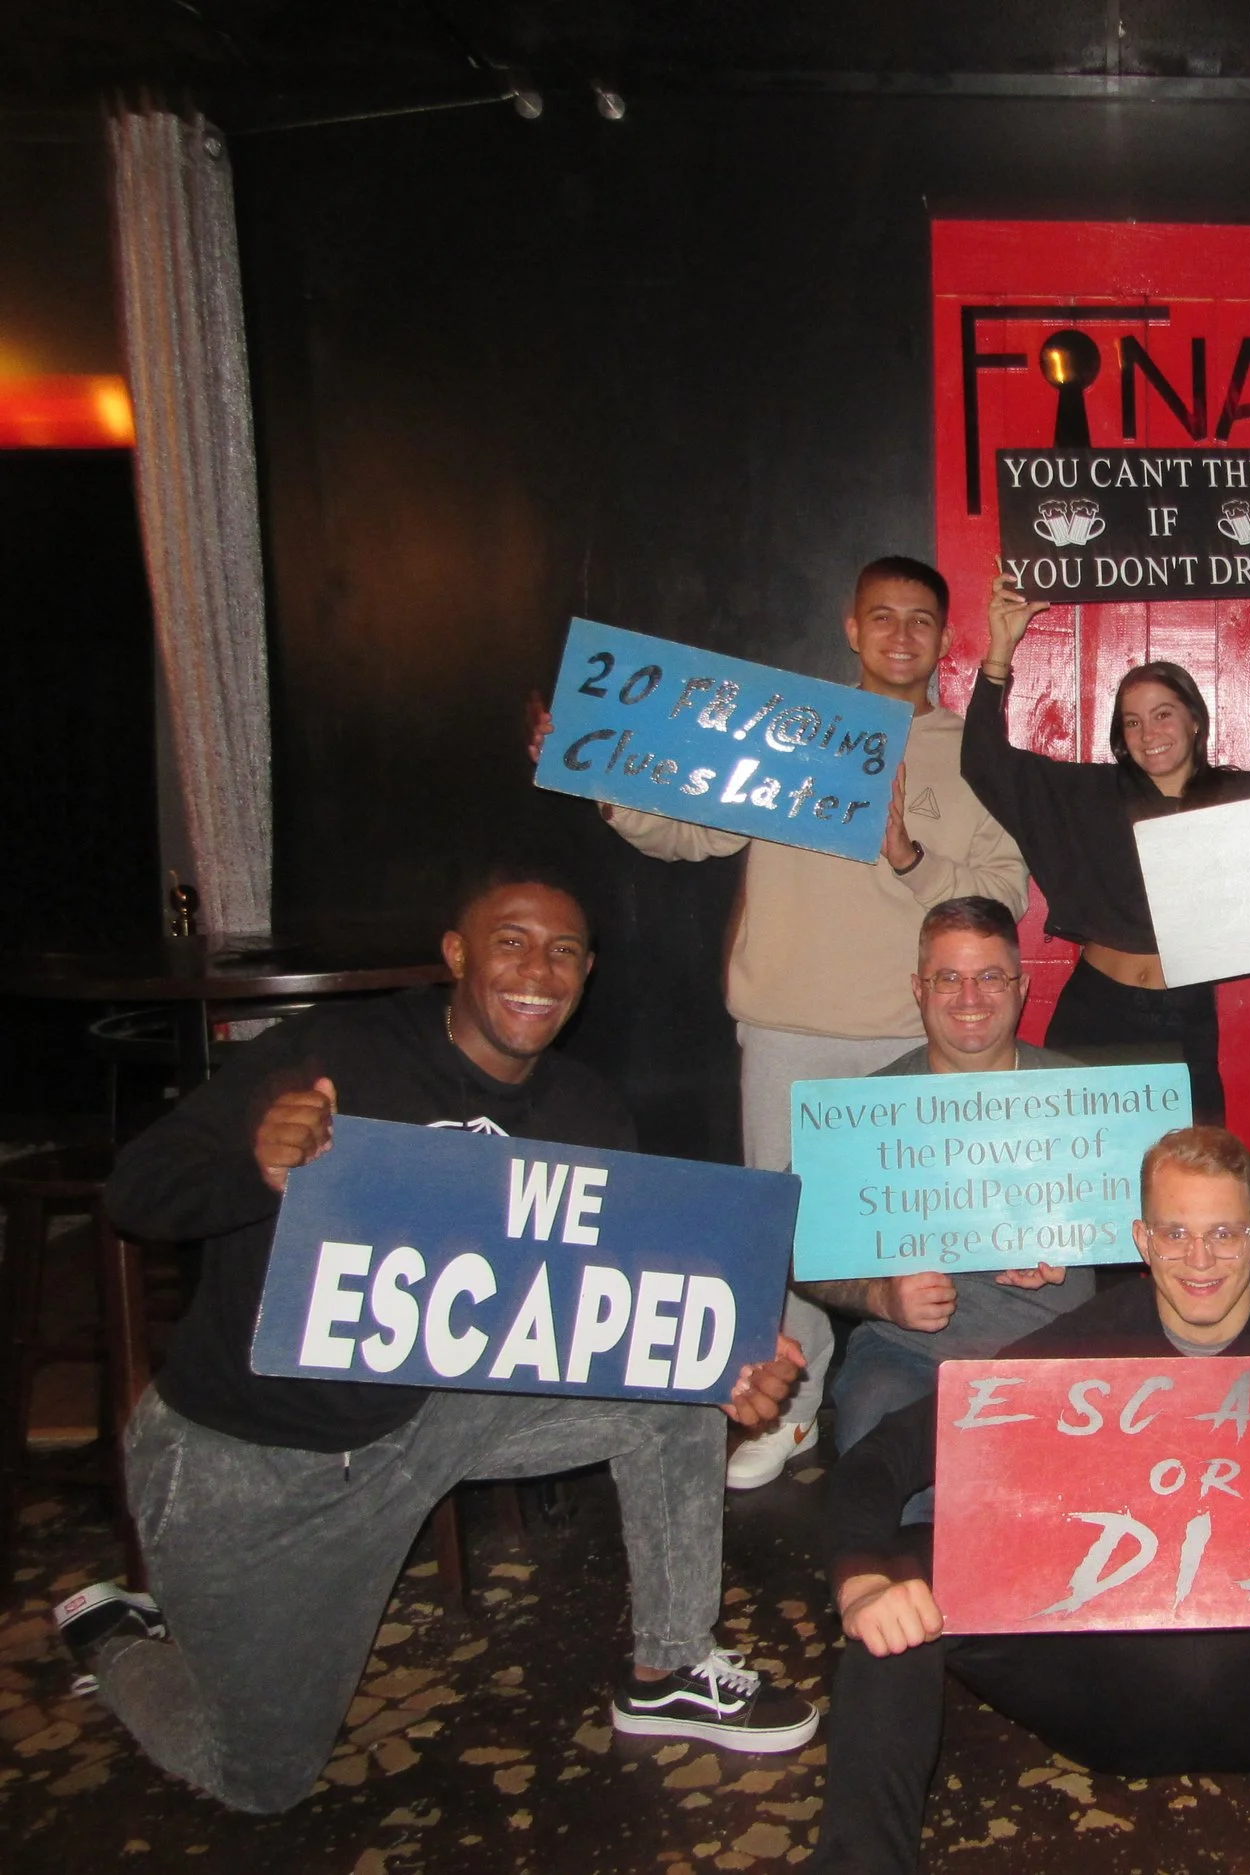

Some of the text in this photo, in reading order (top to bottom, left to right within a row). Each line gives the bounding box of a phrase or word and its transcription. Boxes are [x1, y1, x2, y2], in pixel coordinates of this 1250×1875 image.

[1005, 458, 1079, 488] YOU
[1090, 458, 1192, 488] CAN'T
[1148, 507, 1178, 537] IF
[1007, 558, 1083, 589] YOU
[1095, 556, 1199, 587] DON'T
[563, 729, 871, 825] Clues Later
[801, 1083, 1180, 1130] Never Underestimate
[876, 1127, 1108, 1170] the Power of
[506, 1158, 609, 1246] WE
[858, 1172, 1131, 1222] Stupid People in
[875, 1220, 1117, 1264] Large Groups
[299, 1241, 737, 1390] ESCAPED
[1149, 1457, 1245, 1500] OR
